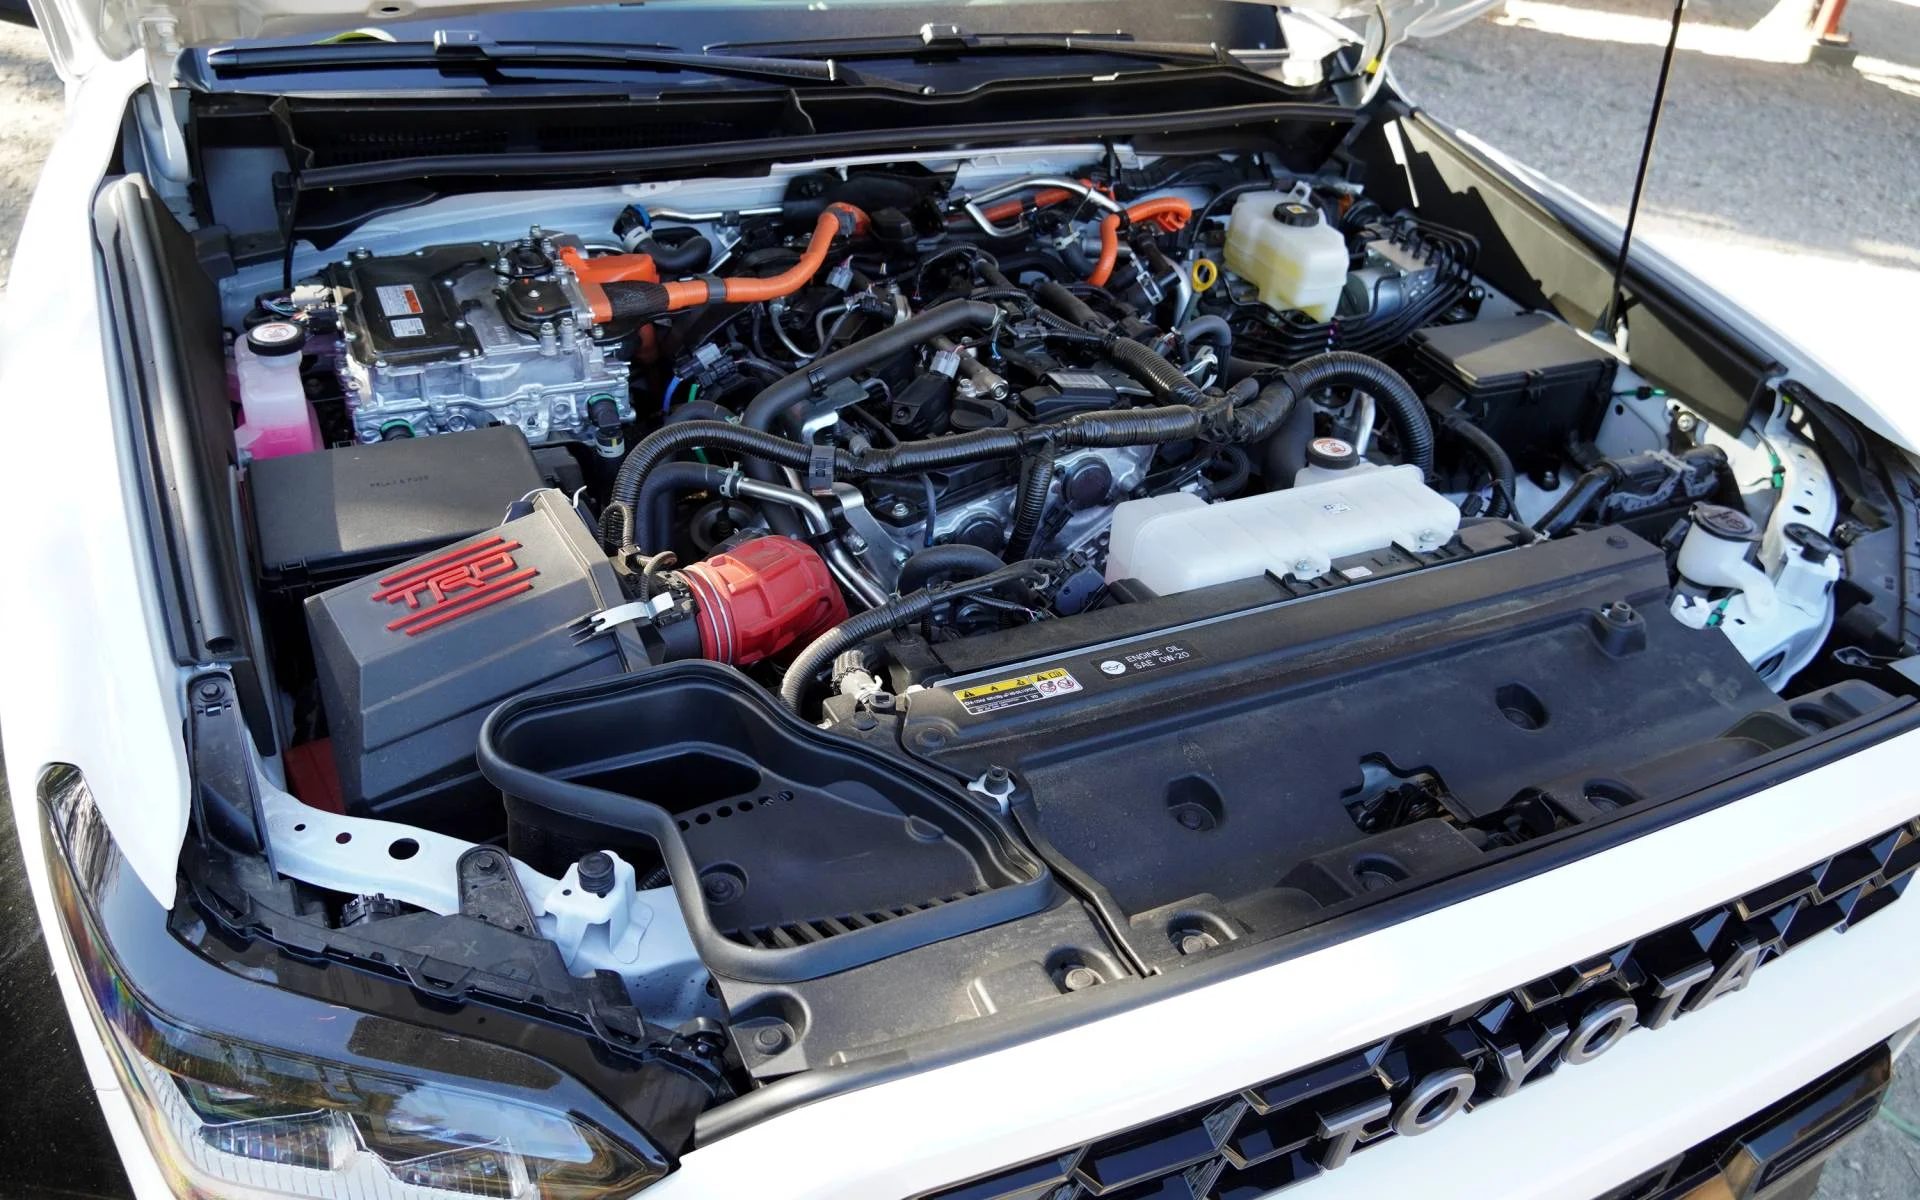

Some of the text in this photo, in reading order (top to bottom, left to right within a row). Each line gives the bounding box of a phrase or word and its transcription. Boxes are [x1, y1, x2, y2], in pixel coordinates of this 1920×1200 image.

[386, 551, 516, 610] TRD
[1125, 644, 1184, 663] ENGINE OIL
[1133, 651, 1190, 670] SAE 0W-20
[1317, 937, 1760, 1171] TOYOTA
